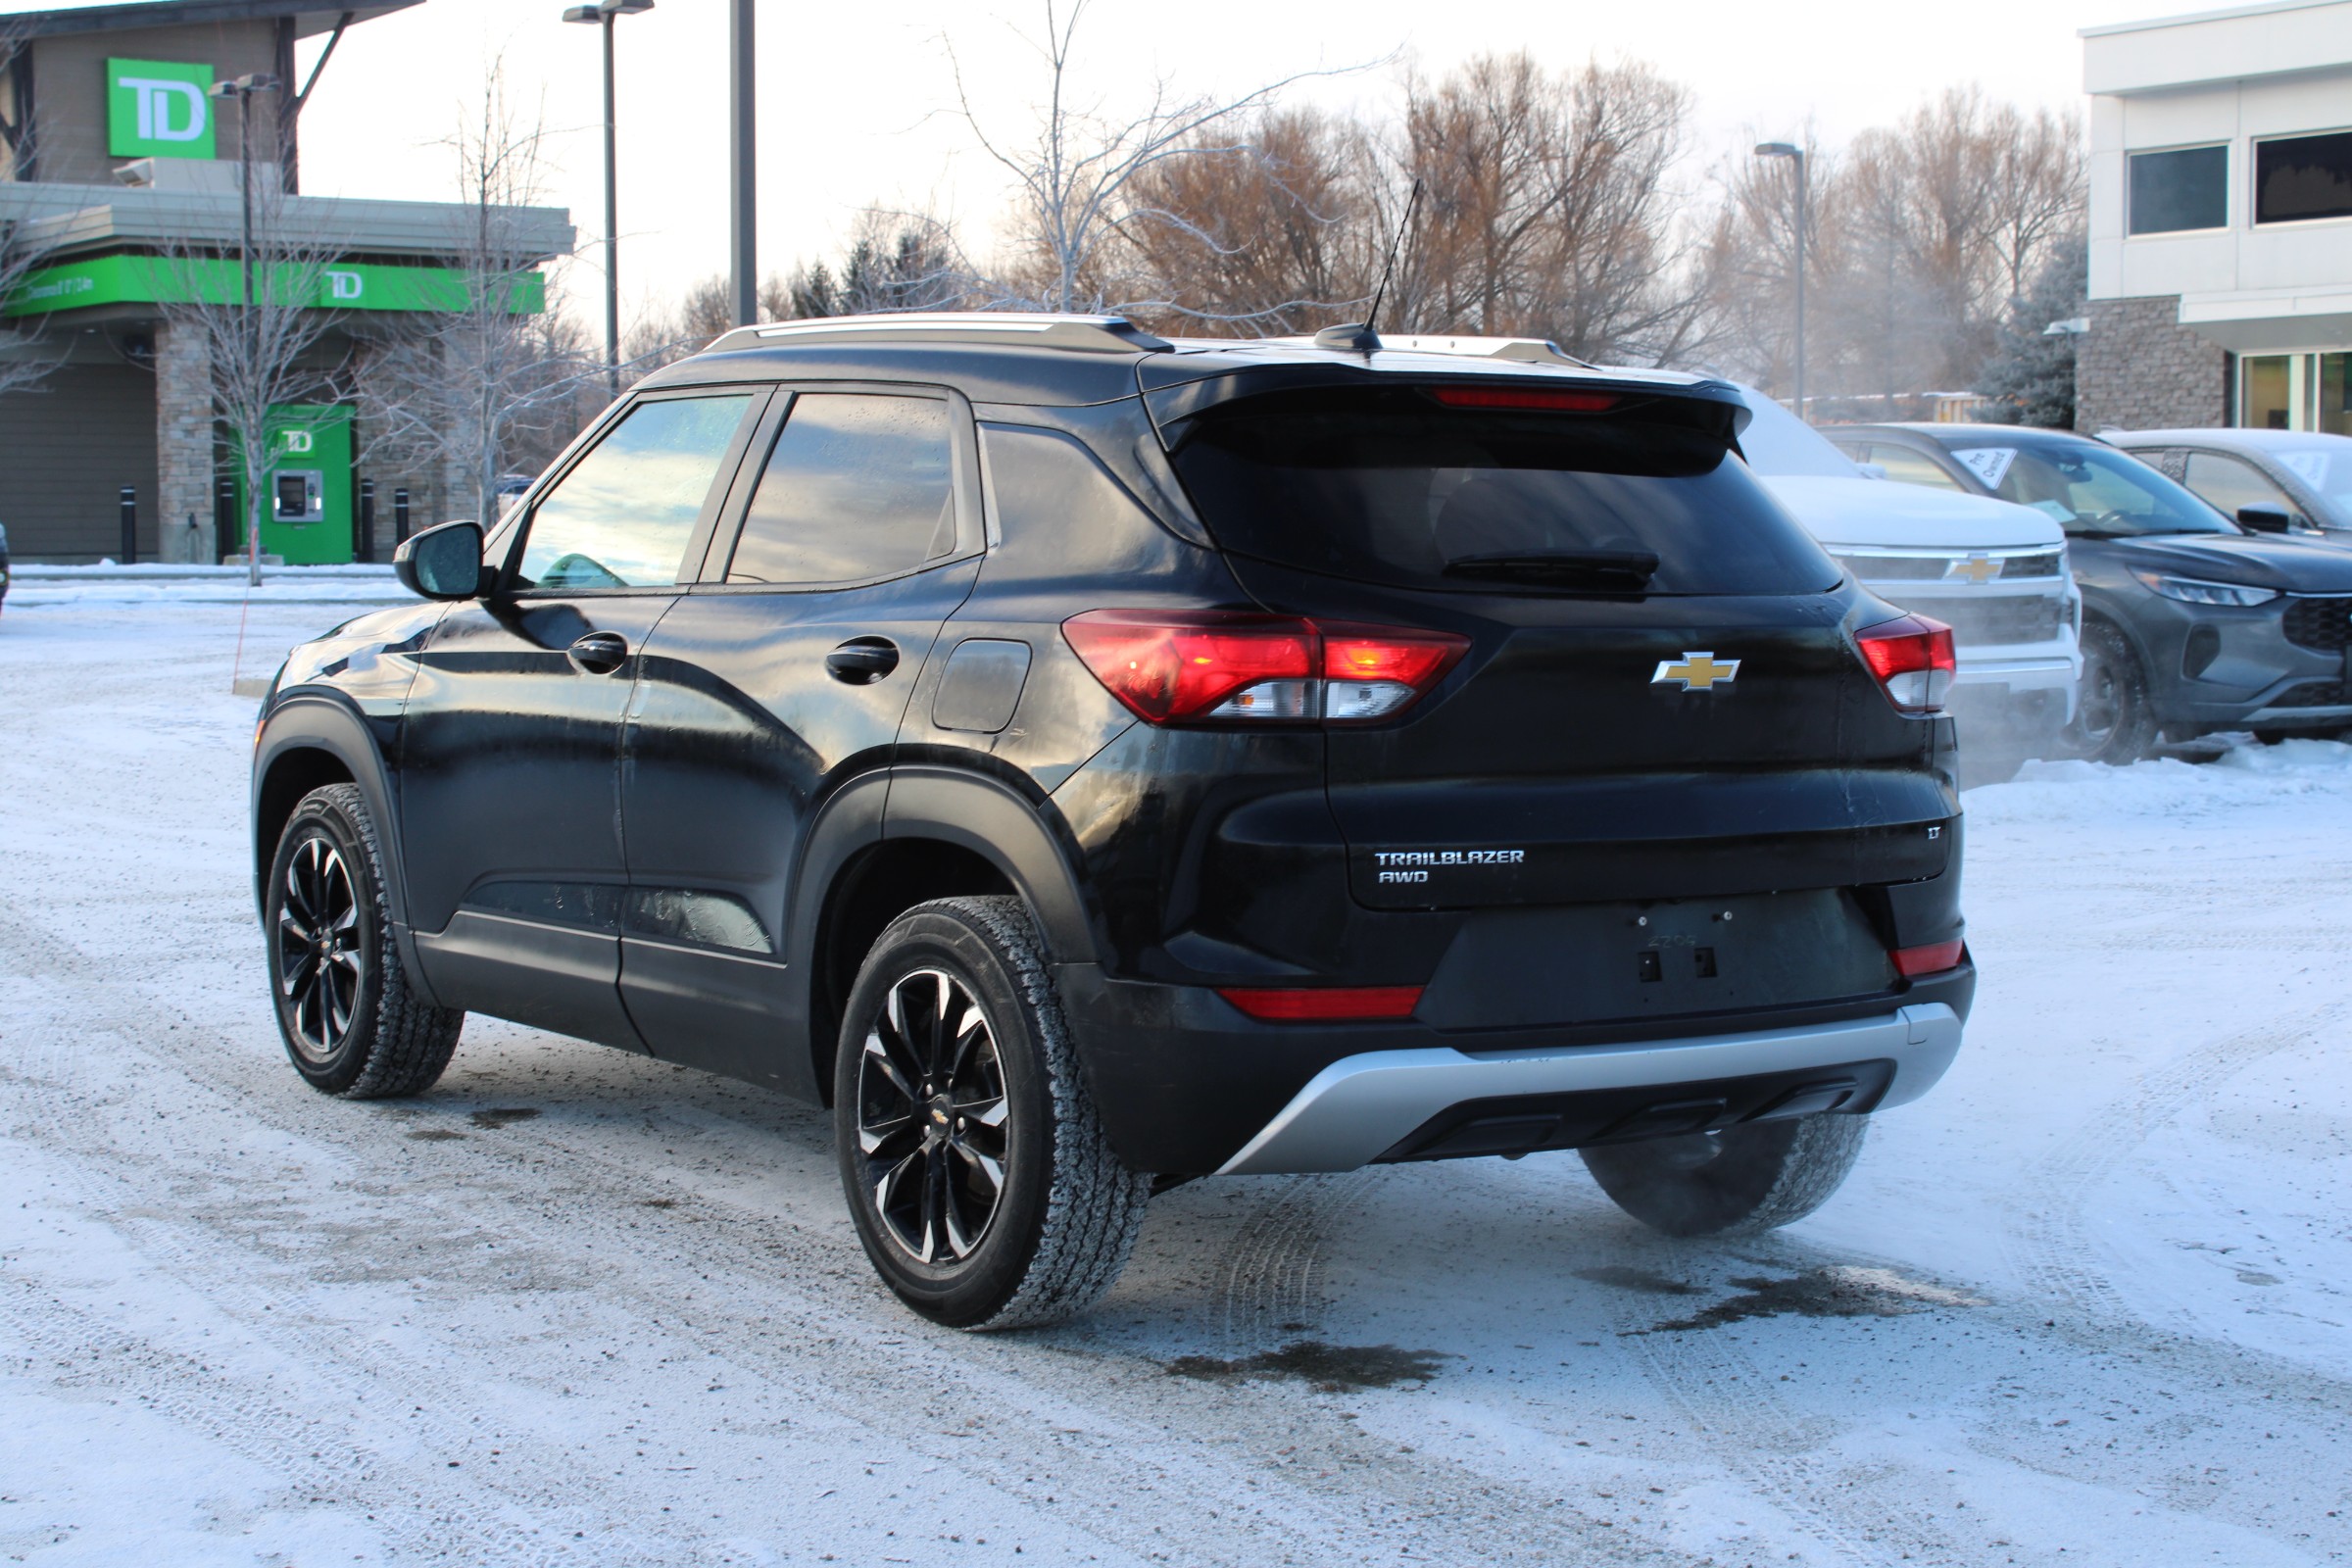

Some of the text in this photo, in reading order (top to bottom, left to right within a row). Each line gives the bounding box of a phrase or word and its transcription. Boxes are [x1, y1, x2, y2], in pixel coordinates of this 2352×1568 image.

[119, 77, 207, 142] TD
[325, 270, 363, 299] TD
[282, 430, 314, 453] TD
[1374, 850, 1525, 866] TRAILBLAZER
[1378, 870, 1429, 884] AWD
